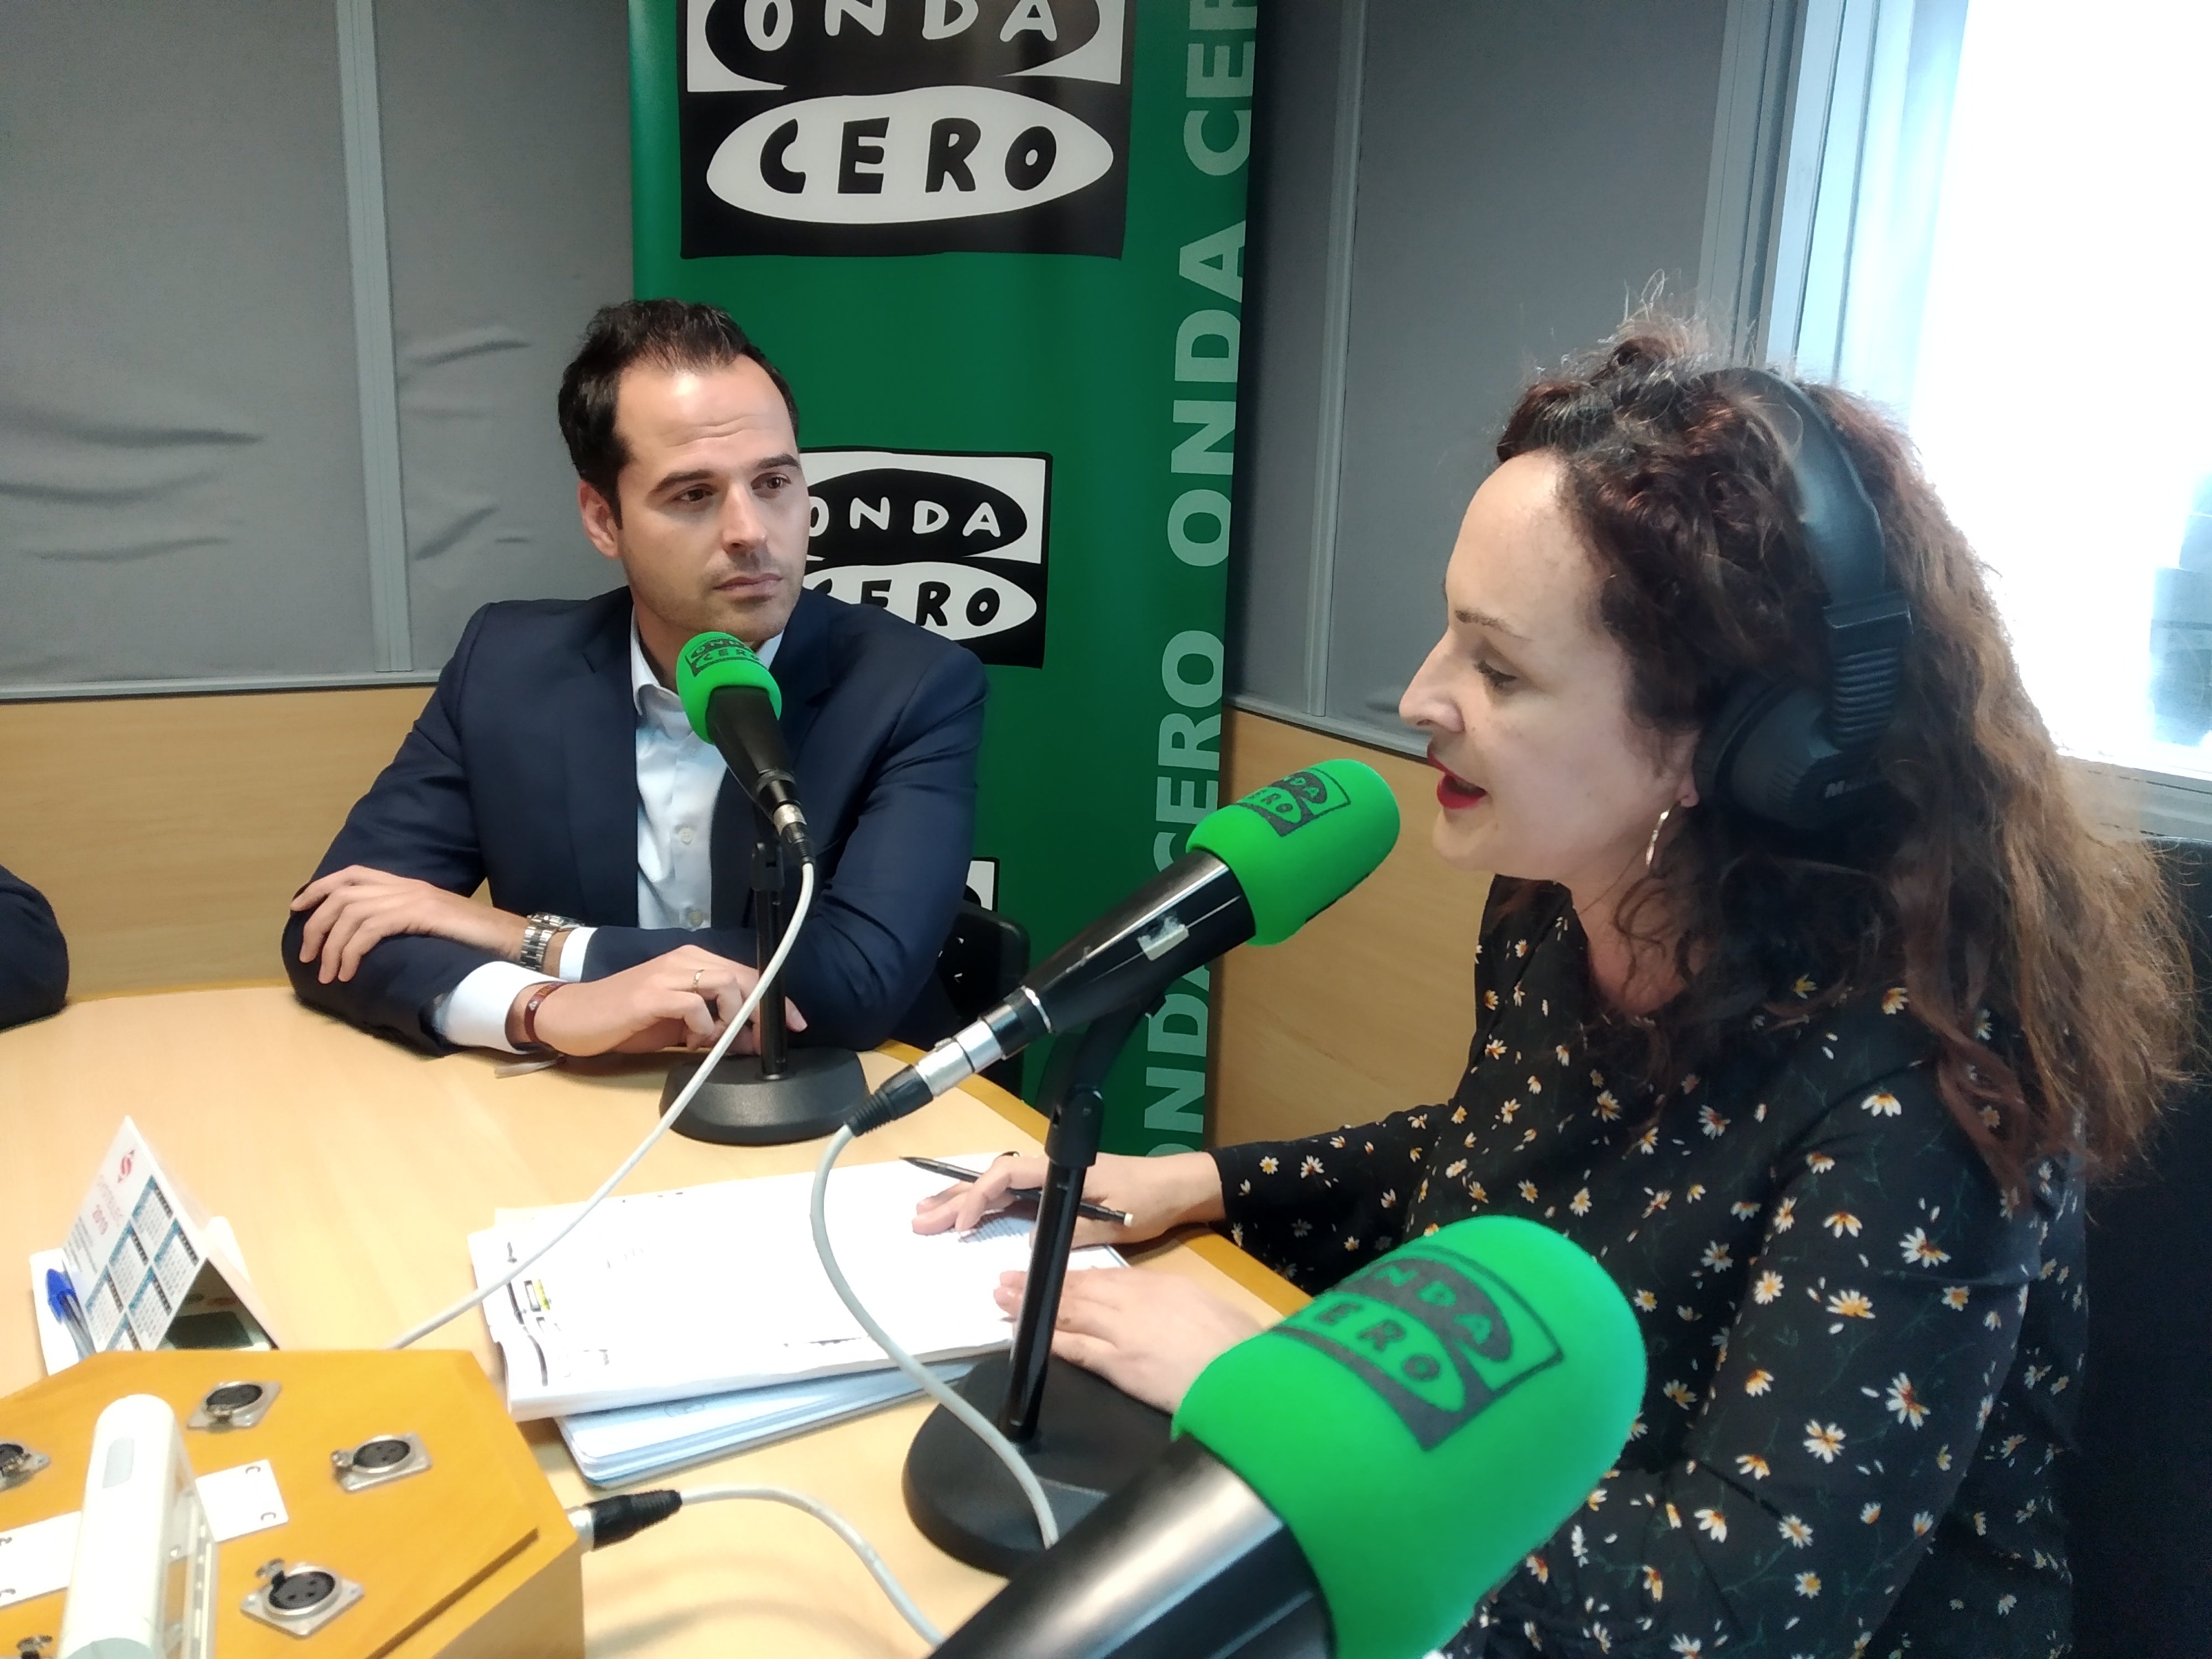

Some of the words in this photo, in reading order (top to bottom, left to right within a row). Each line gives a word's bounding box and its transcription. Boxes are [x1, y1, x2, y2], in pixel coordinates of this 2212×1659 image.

[743, 0, 1058, 51] ONDA
[759, 116, 1058, 195] CERO
[1167, 220, 1246, 567] ONDA
[808, 497, 1001, 538] ONDA
[1248, 790, 1293, 813] ERO
[1144, 965, 1210, 1157] ND
[1314, 1302, 1441, 1381] ERO
[1374, 1265, 1493, 1344] NDA
